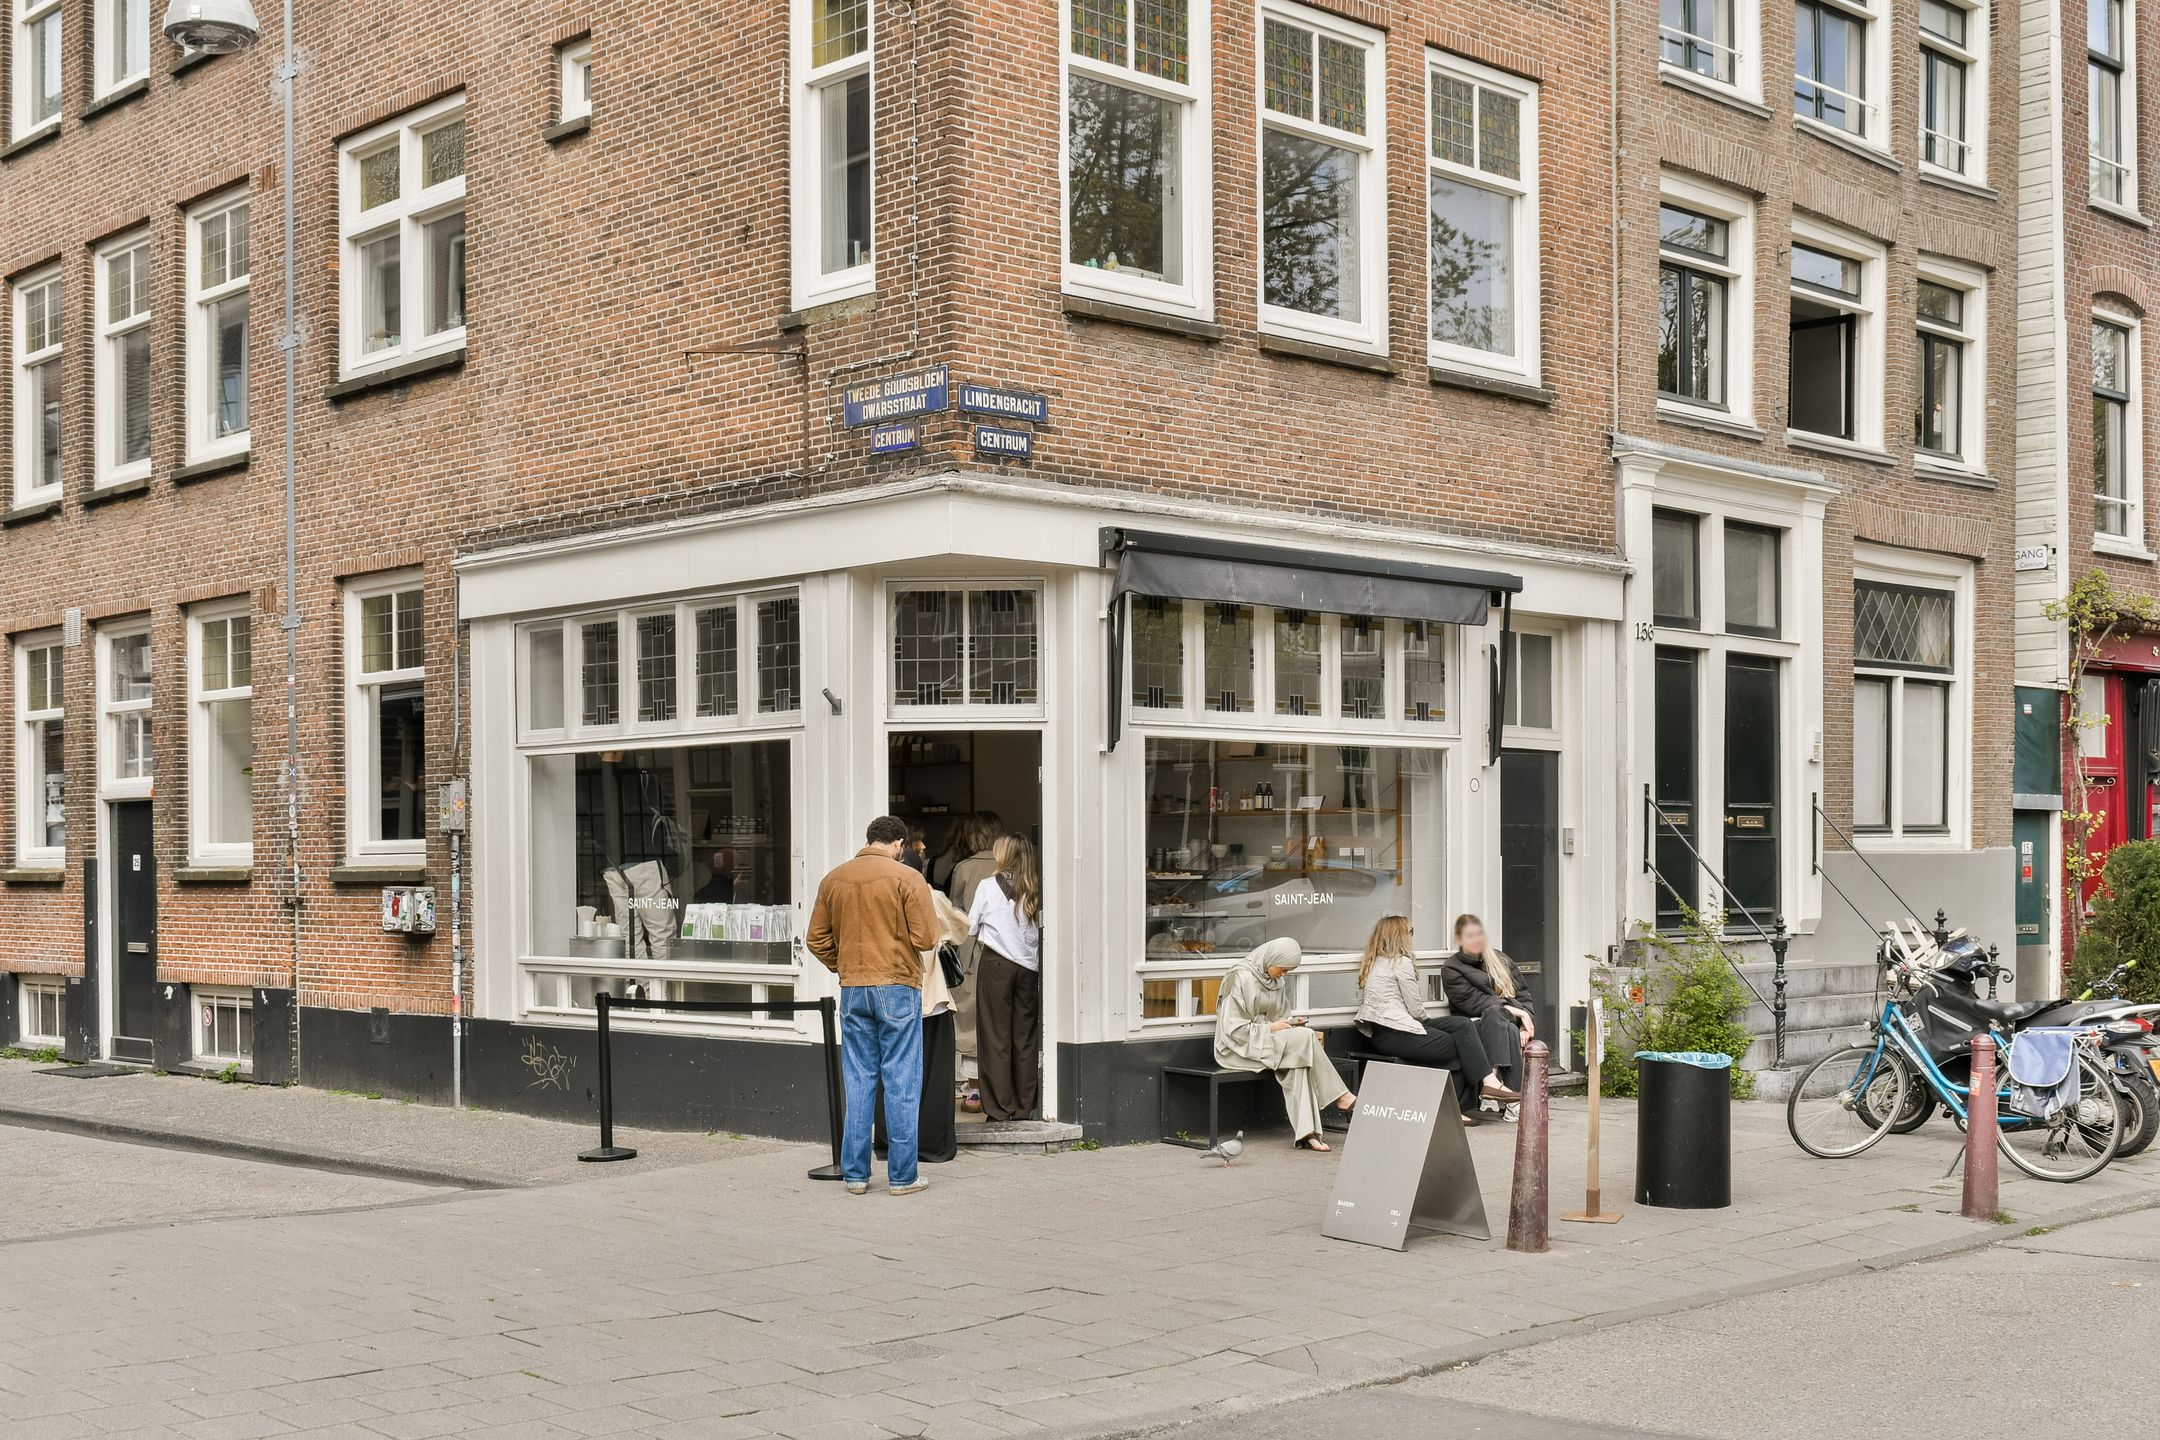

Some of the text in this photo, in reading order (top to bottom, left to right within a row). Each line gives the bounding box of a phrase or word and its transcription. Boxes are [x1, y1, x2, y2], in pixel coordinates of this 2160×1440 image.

[847, 370, 944, 405] TWEEDE GOUDSBLOEM
[862, 394, 927, 420] DWARSSTRAAT
[964, 390, 1041, 416] LINDENGRACHT
[874, 428, 915, 448] CENTRUM
[980, 431, 1027, 452] CENTRUM
[1635, 622, 1654, 641] 156
[628, 898, 679, 909] SAINT-JEAN
[1274, 892, 1334, 905] SAINT-JEAN
[1362, 1103, 1428, 1124] SAINT-JEAN
